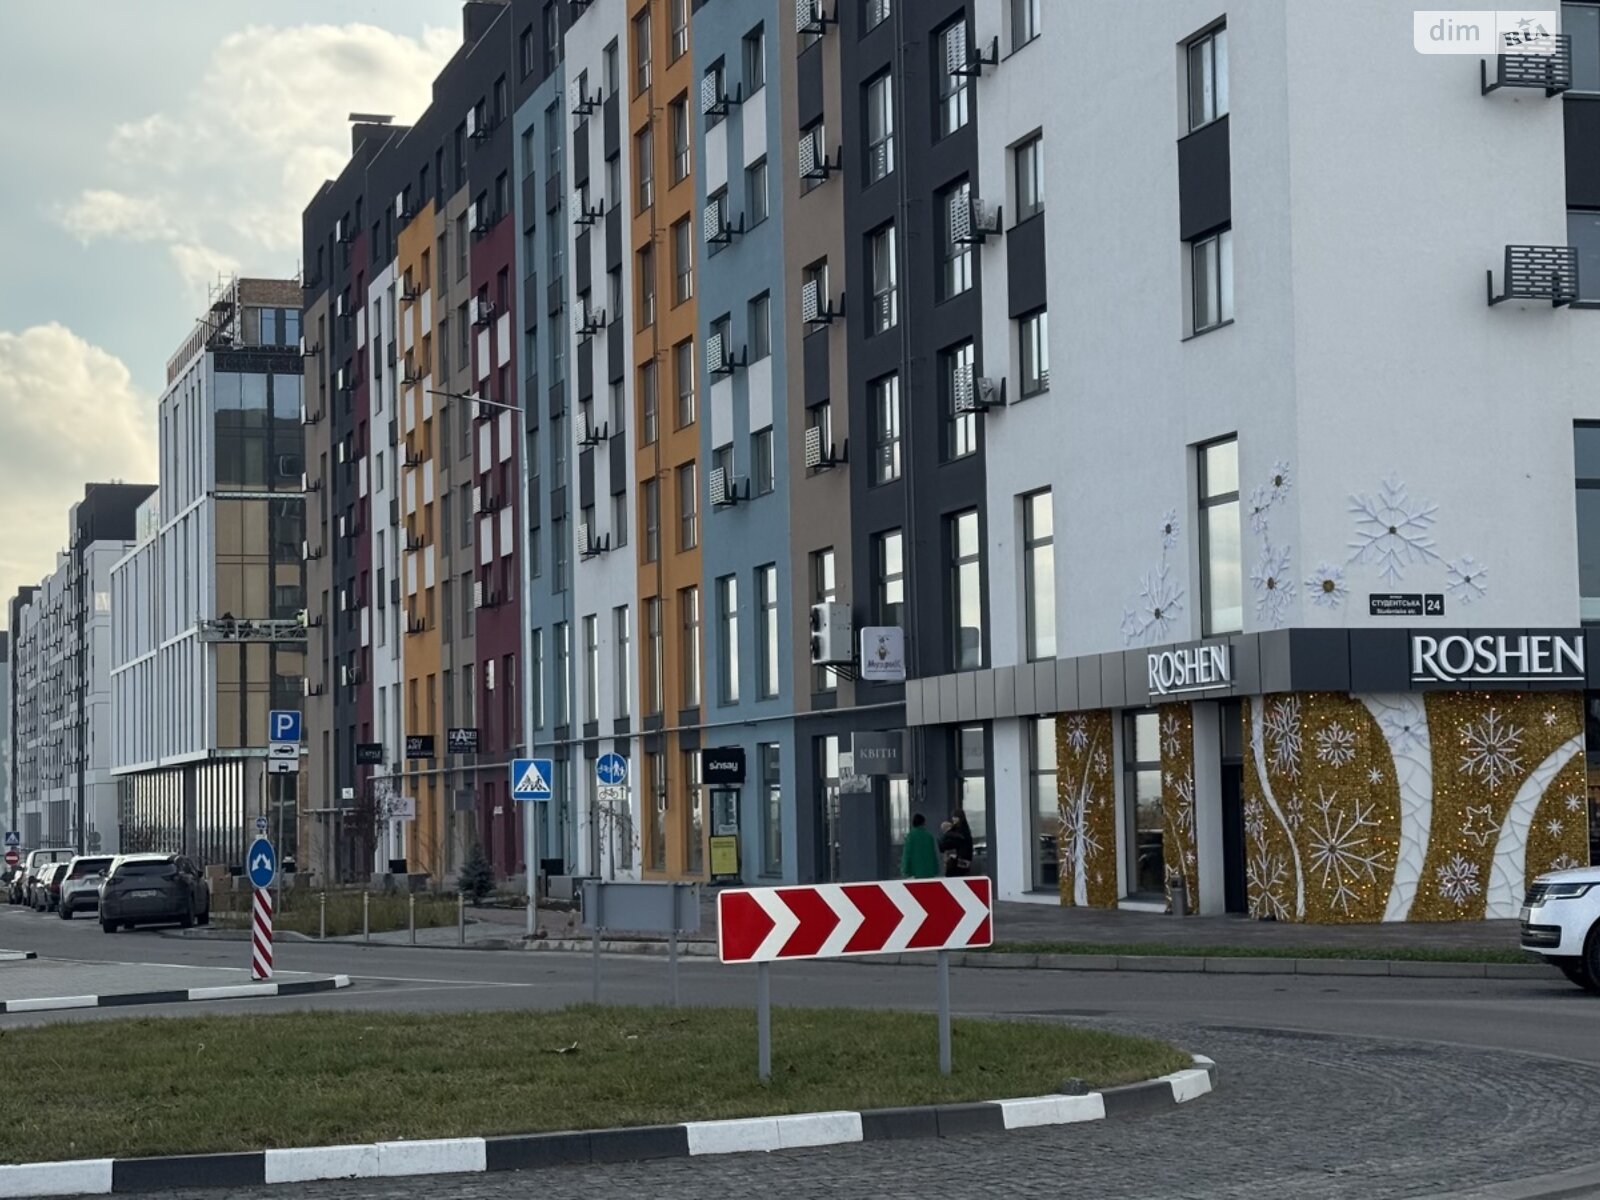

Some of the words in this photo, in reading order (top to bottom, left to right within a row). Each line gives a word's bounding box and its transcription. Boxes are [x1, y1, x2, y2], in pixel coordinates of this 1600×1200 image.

[1371, 599, 1421, 607] СТУДЕНТСЬКА
[1426, 599, 1441, 611] 24
[1411, 635, 1585, 682] ROSHEN
[1147, 644, 1230, 695] ROSHEN
[277, 714, 294, 738] P
[860, 747, 896, 758] КВІТИ
[709, 760, 738, 772] sinsay
